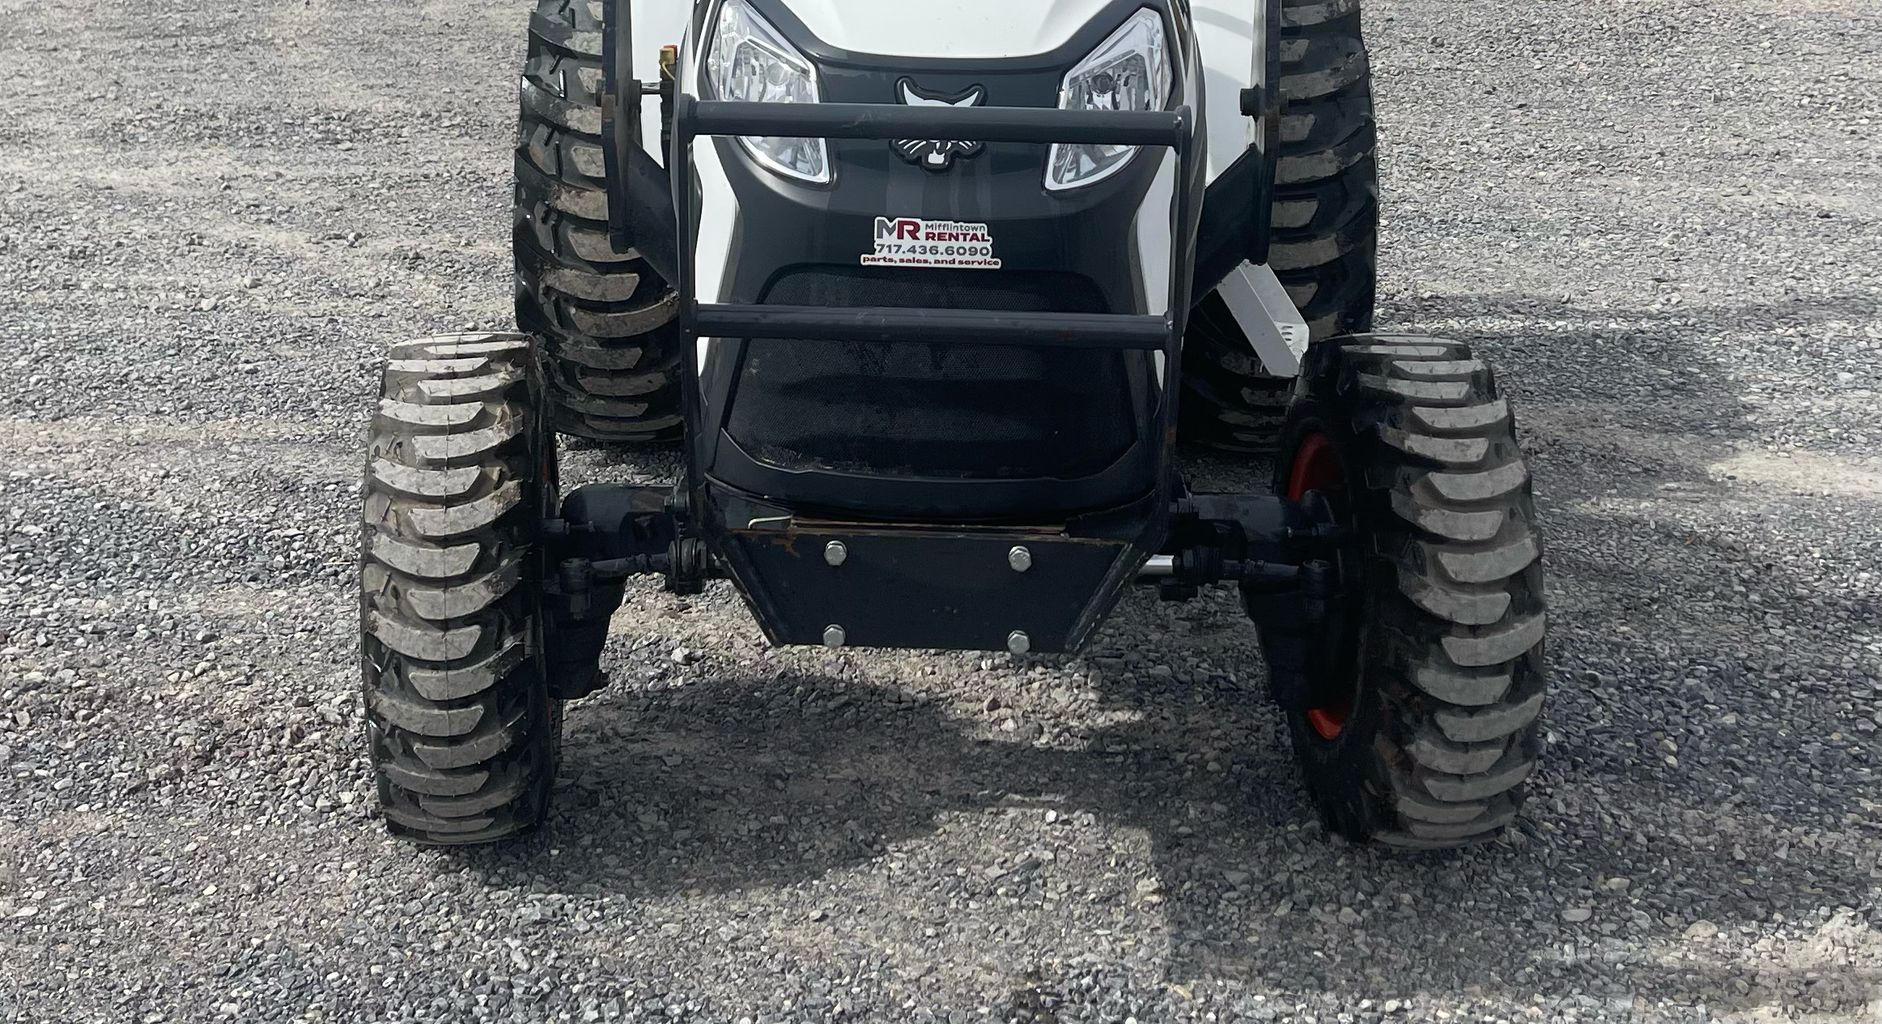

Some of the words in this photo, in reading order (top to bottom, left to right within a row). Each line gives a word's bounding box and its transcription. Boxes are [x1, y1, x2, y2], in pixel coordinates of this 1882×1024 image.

[876, 219, 920, 240] MR
[925, 222, 986, 232] Mifflintown
[925, 232, 990, 242] RENTAL
[876, 243, 990, 256] 717.436.6090
[862, 256, 897, 264] parts,
[899, 257, 932, 265] sales,
[934, 258, 956, 266] and
